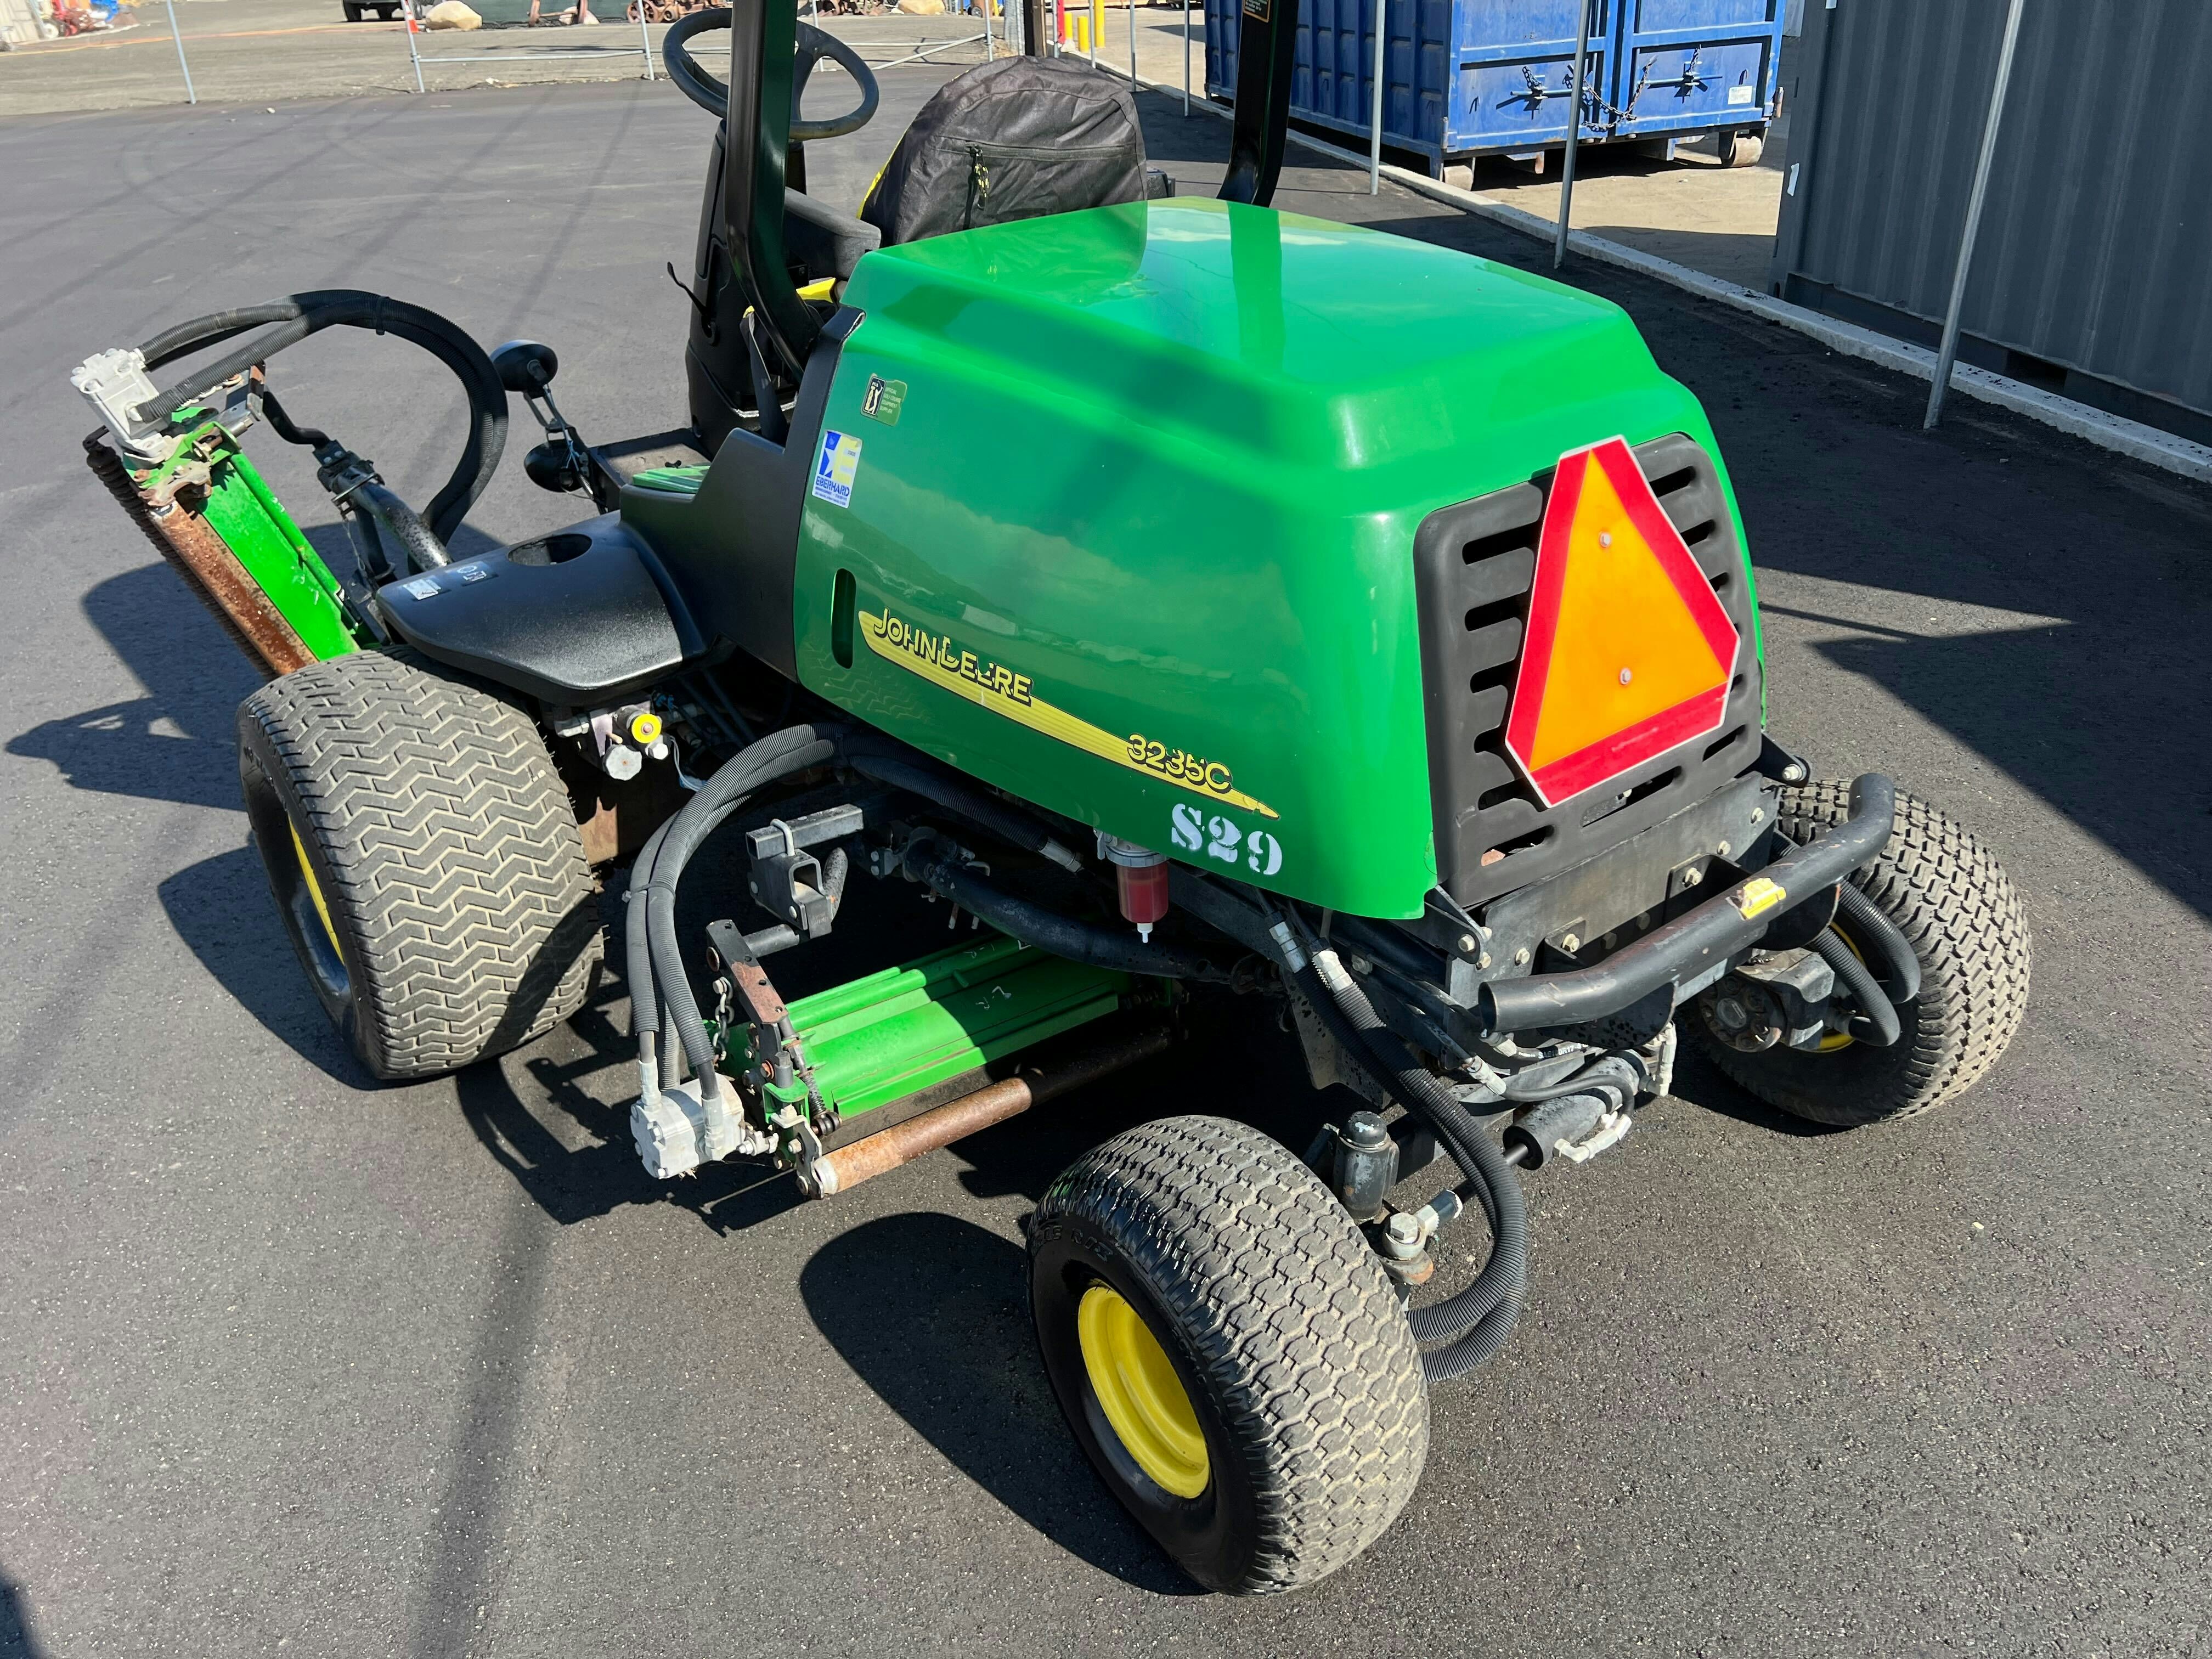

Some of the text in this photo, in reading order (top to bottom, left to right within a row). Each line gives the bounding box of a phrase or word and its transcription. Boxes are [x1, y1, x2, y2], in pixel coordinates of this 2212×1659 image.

[815, 476, 850, 496] EBERHARD
[873, 607, 939, 665] JOHN
[1127, 732, 1233, 794] 3235C
[1171, 803, 1283, 876] S29
